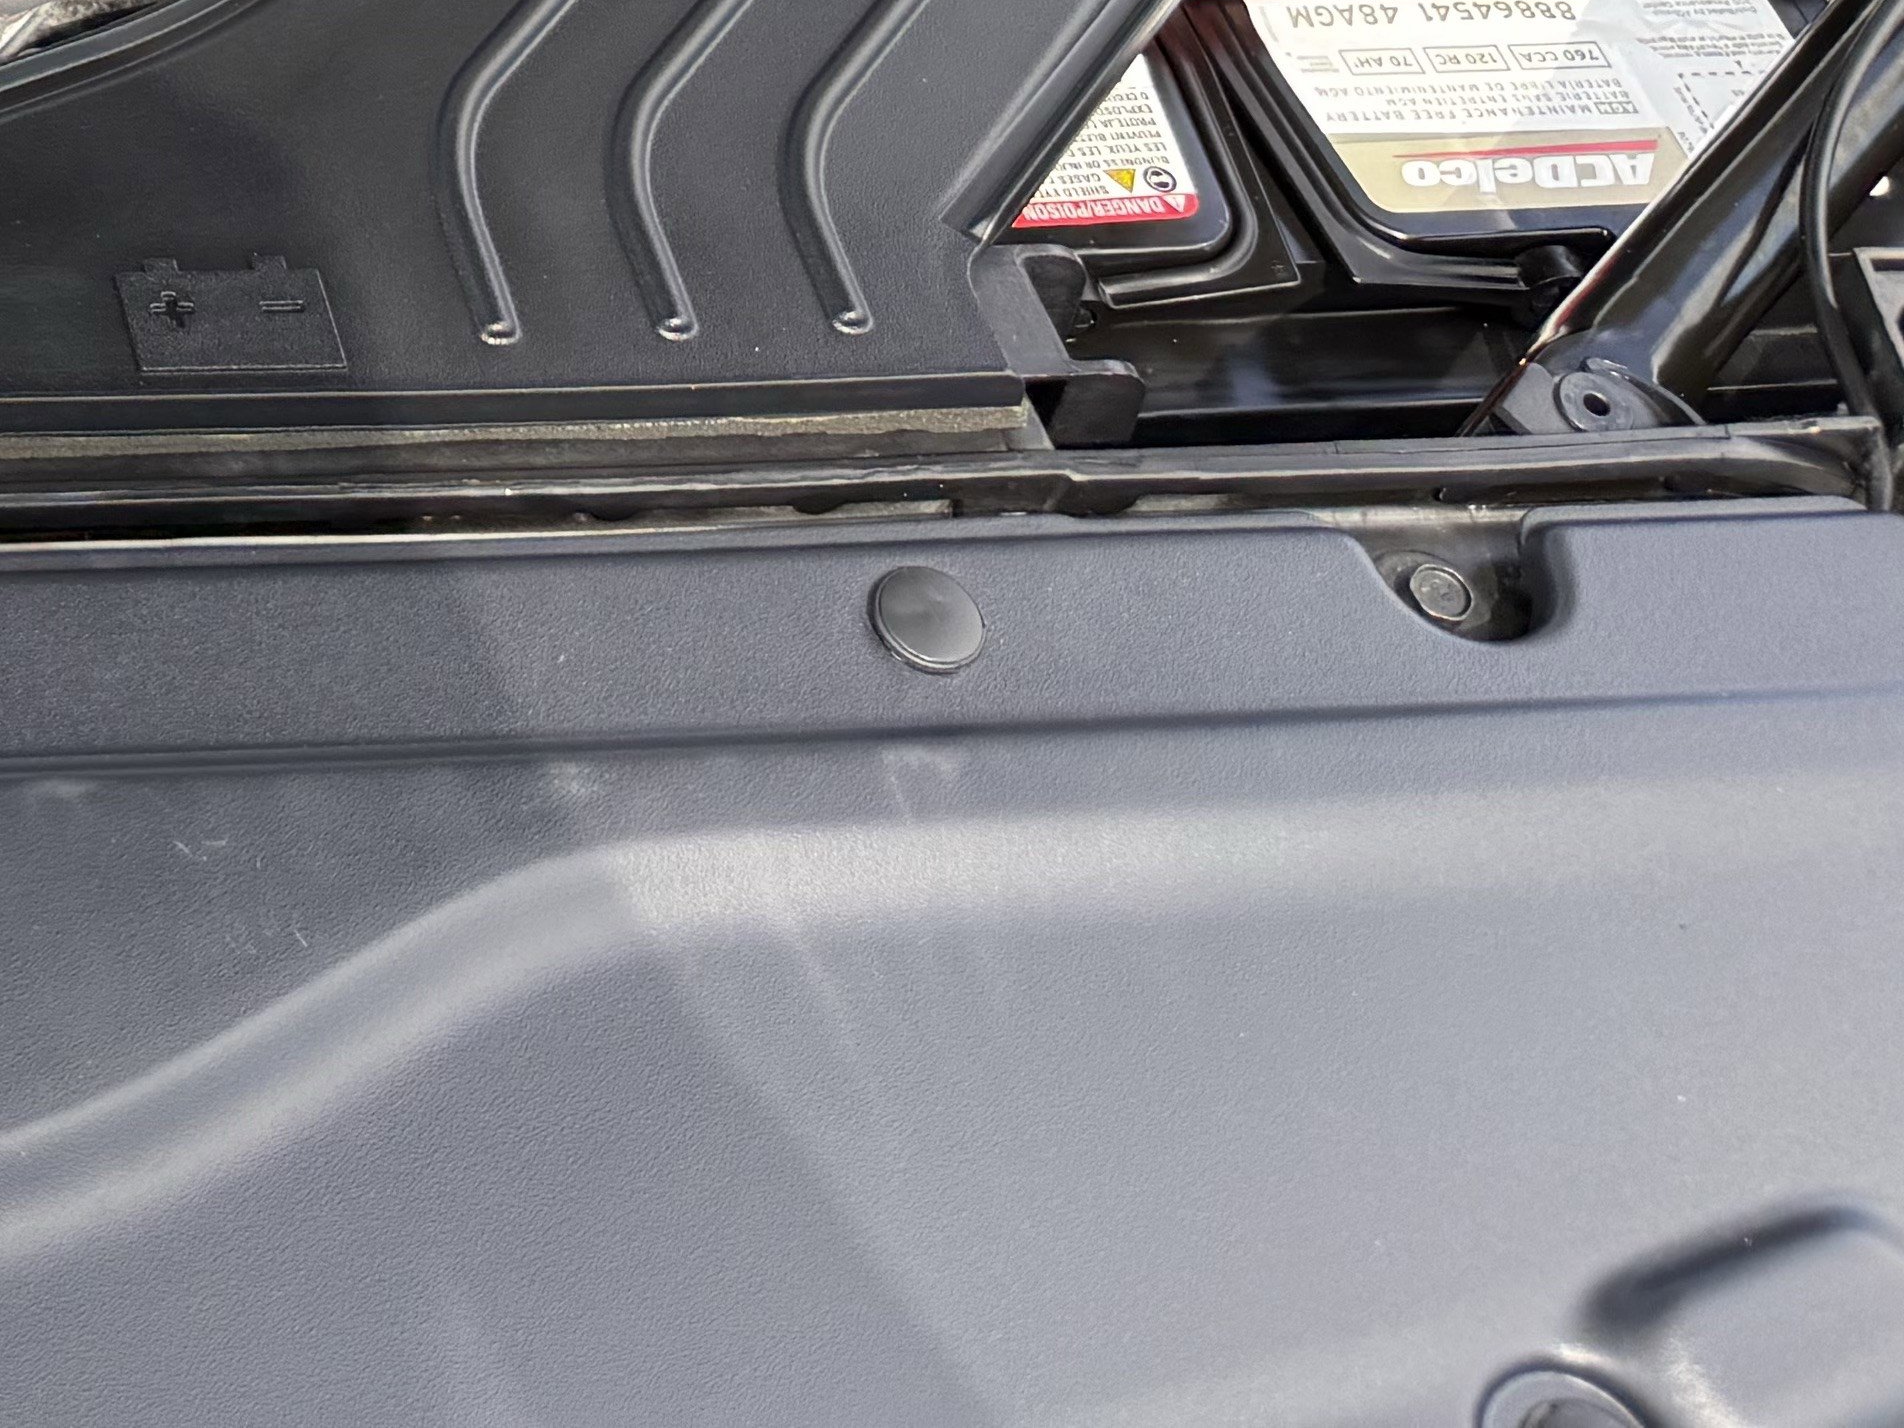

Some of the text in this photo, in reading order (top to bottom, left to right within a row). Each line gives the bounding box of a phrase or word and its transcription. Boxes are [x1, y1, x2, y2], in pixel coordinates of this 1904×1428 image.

[1286, 1, 1575, 28] 88864541 48AGM
[1389, 54, 1414, 67] 70
[1434, 50, 1497, 66] 120 RC
[1520, 49, 1600, 64] 760 CCA
[1323, 109, 1405, 123] BATTERY
[1462, 104, 1592, 120] MAINTENANCE
[1402, 154, 1655, 192] ACDelco
[1023, 197, 1164, 219] DANGER/POISON
